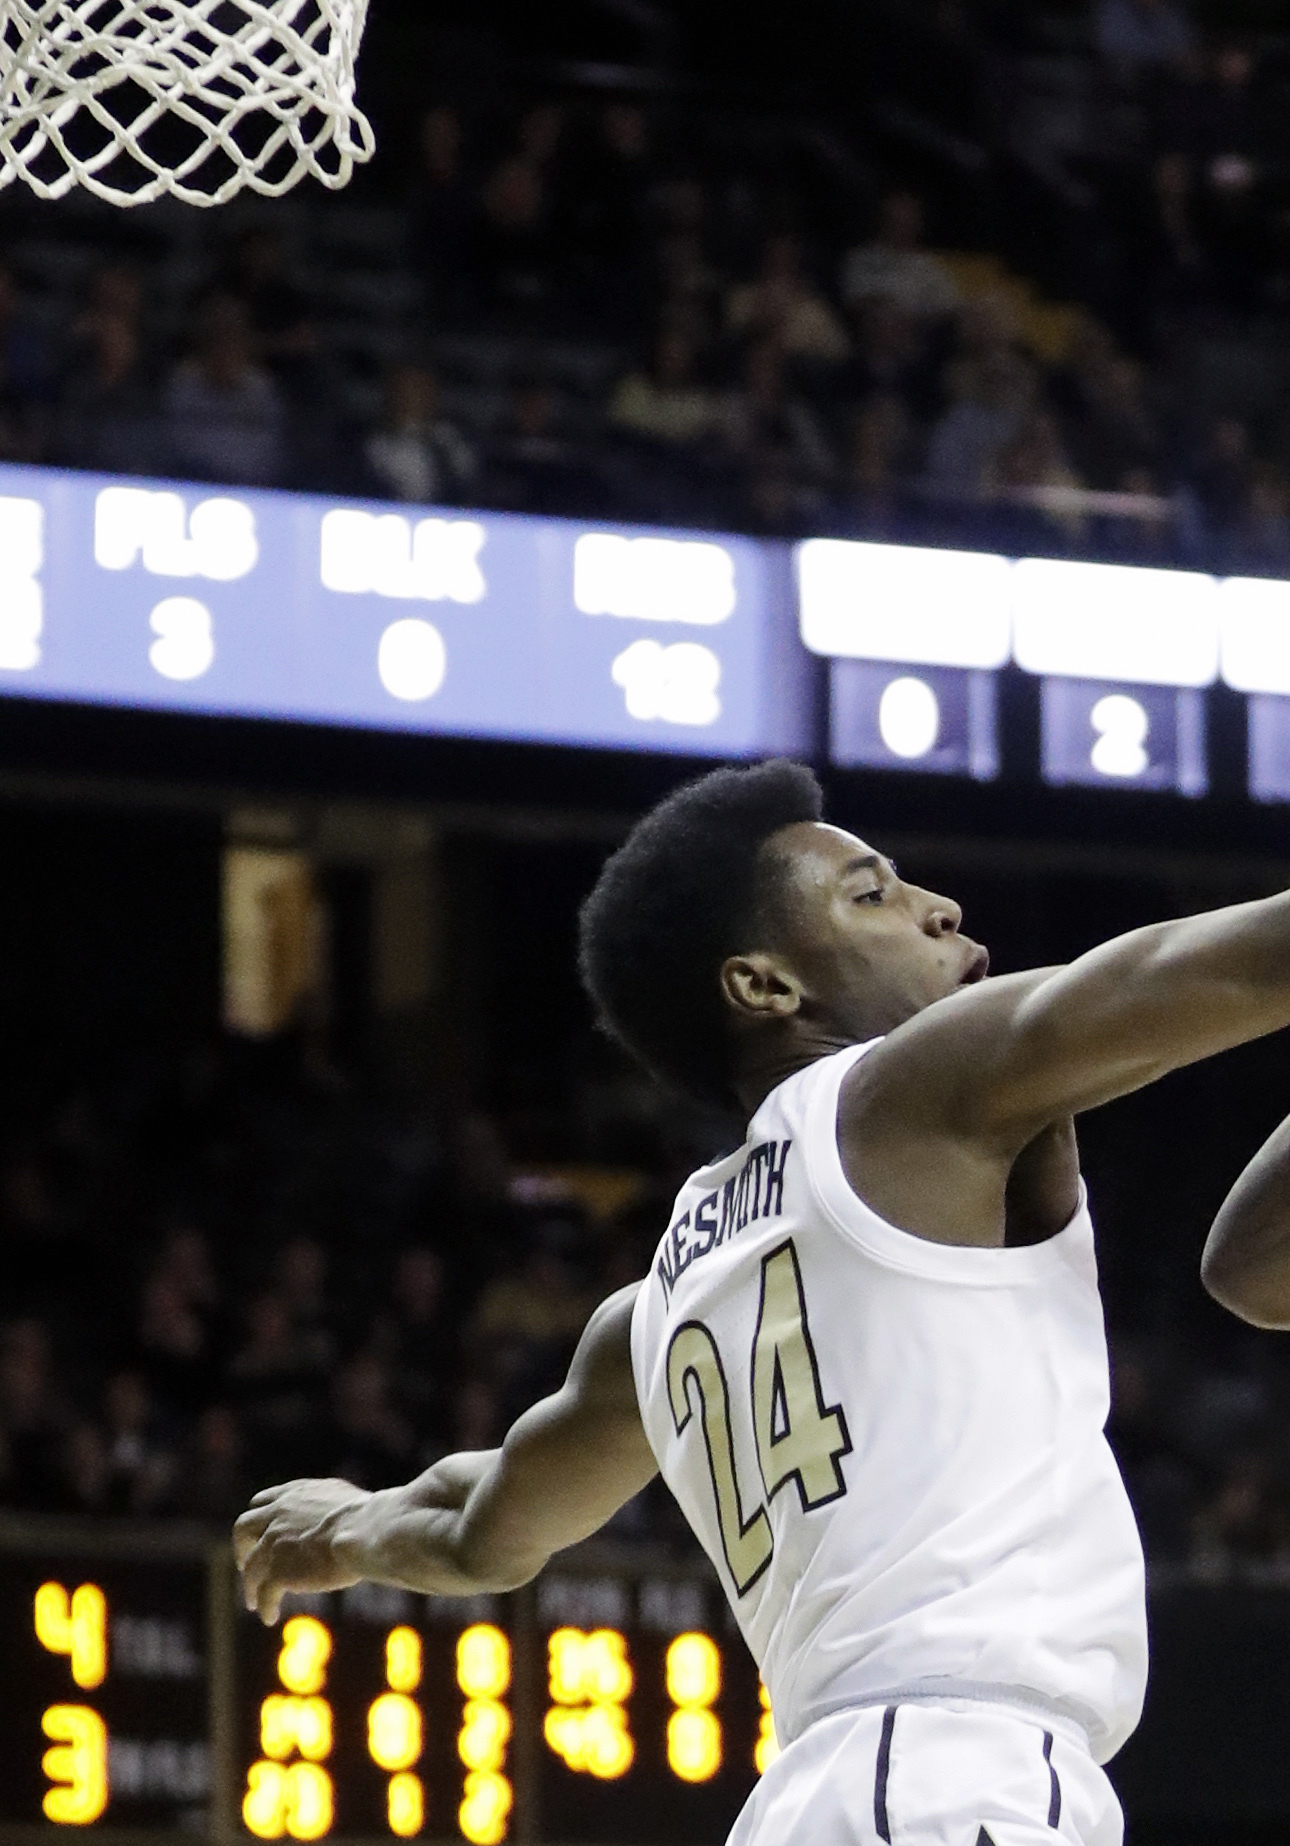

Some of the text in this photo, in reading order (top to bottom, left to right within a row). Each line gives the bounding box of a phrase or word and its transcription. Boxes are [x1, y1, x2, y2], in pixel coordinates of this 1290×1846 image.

[656, 1139, 793, 1312] NESMITH
[667, 1236, 853, 1599] 24
[42, 1703, 107, 1824] 3
